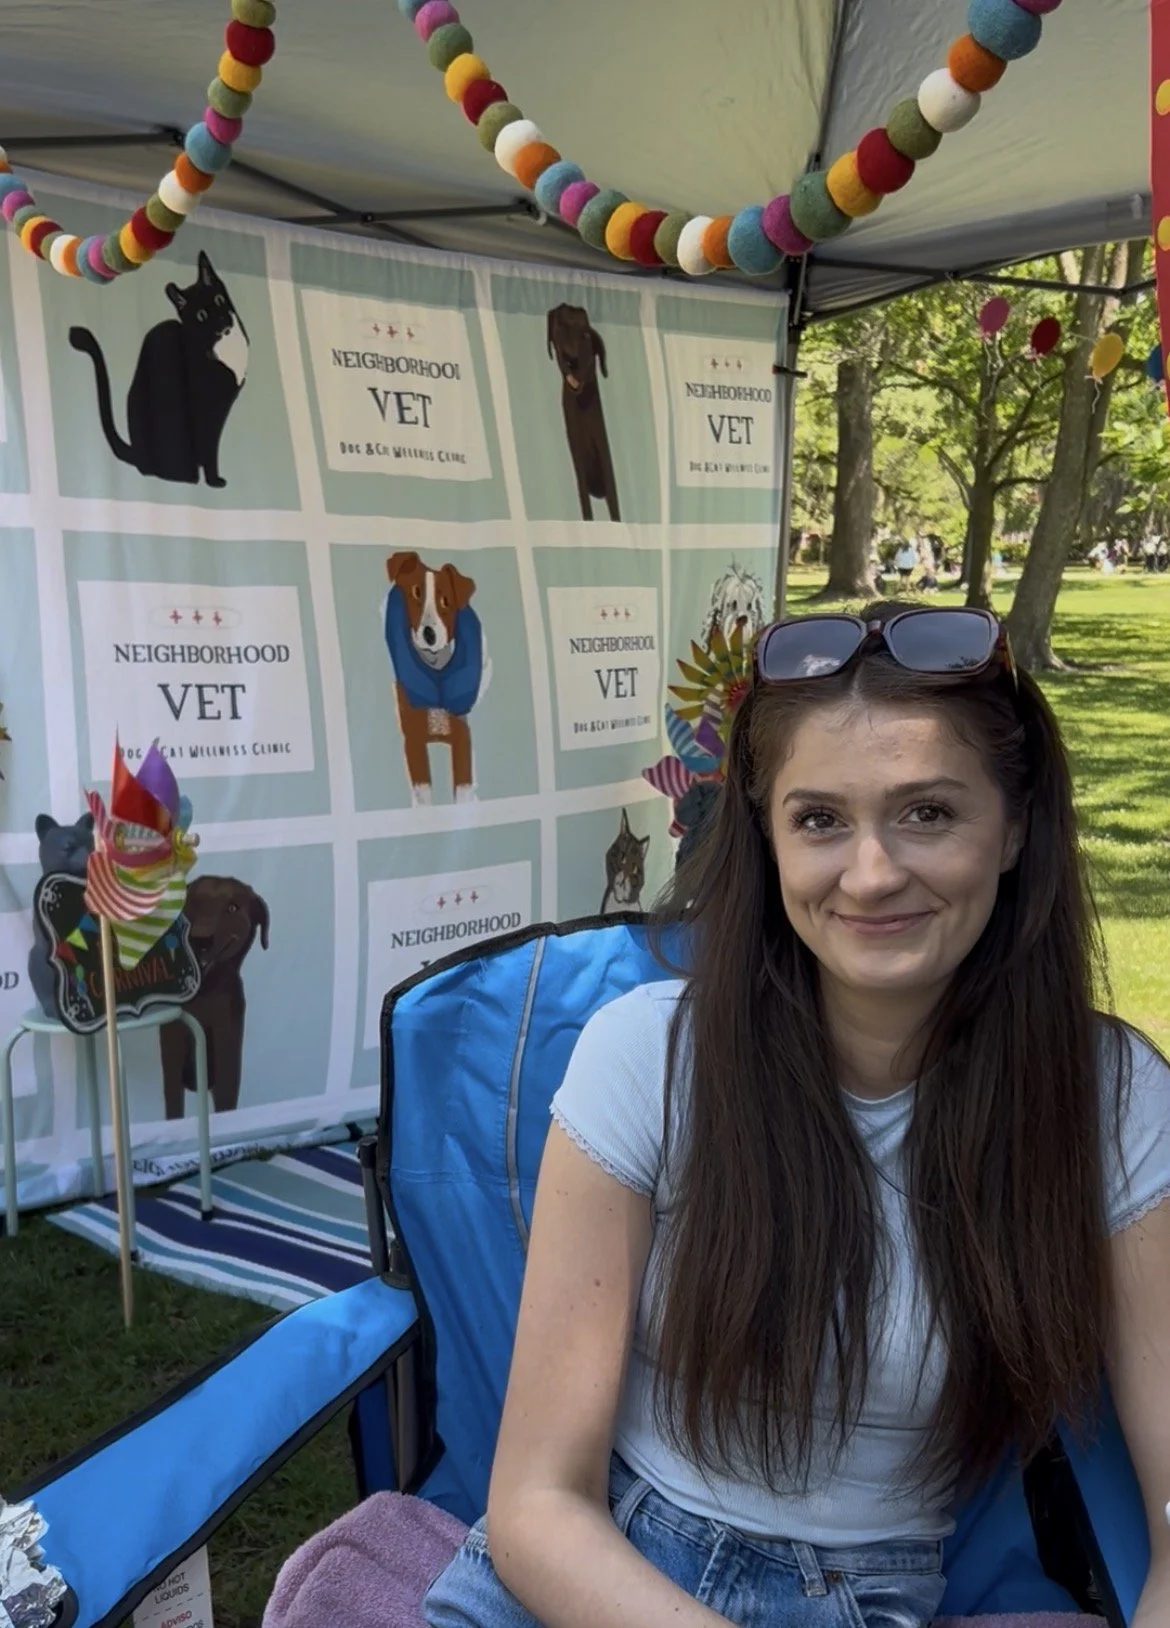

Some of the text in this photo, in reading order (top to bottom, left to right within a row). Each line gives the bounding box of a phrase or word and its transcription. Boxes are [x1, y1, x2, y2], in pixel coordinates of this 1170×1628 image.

[367, 387, 432, 428] VET
[707, 414, 754, 444] VET
[113, 644, 290, 664] NEIGHBORHOOD
[594, 667, 638, 699] VET
[157, 683, 246, 721] VET
[391, 912, 521, 949] NEIGHBORHOOD
[88, 955, 175, 999] CRNIVAL
[154, 1583, 190, 1605] LIQUIDS
